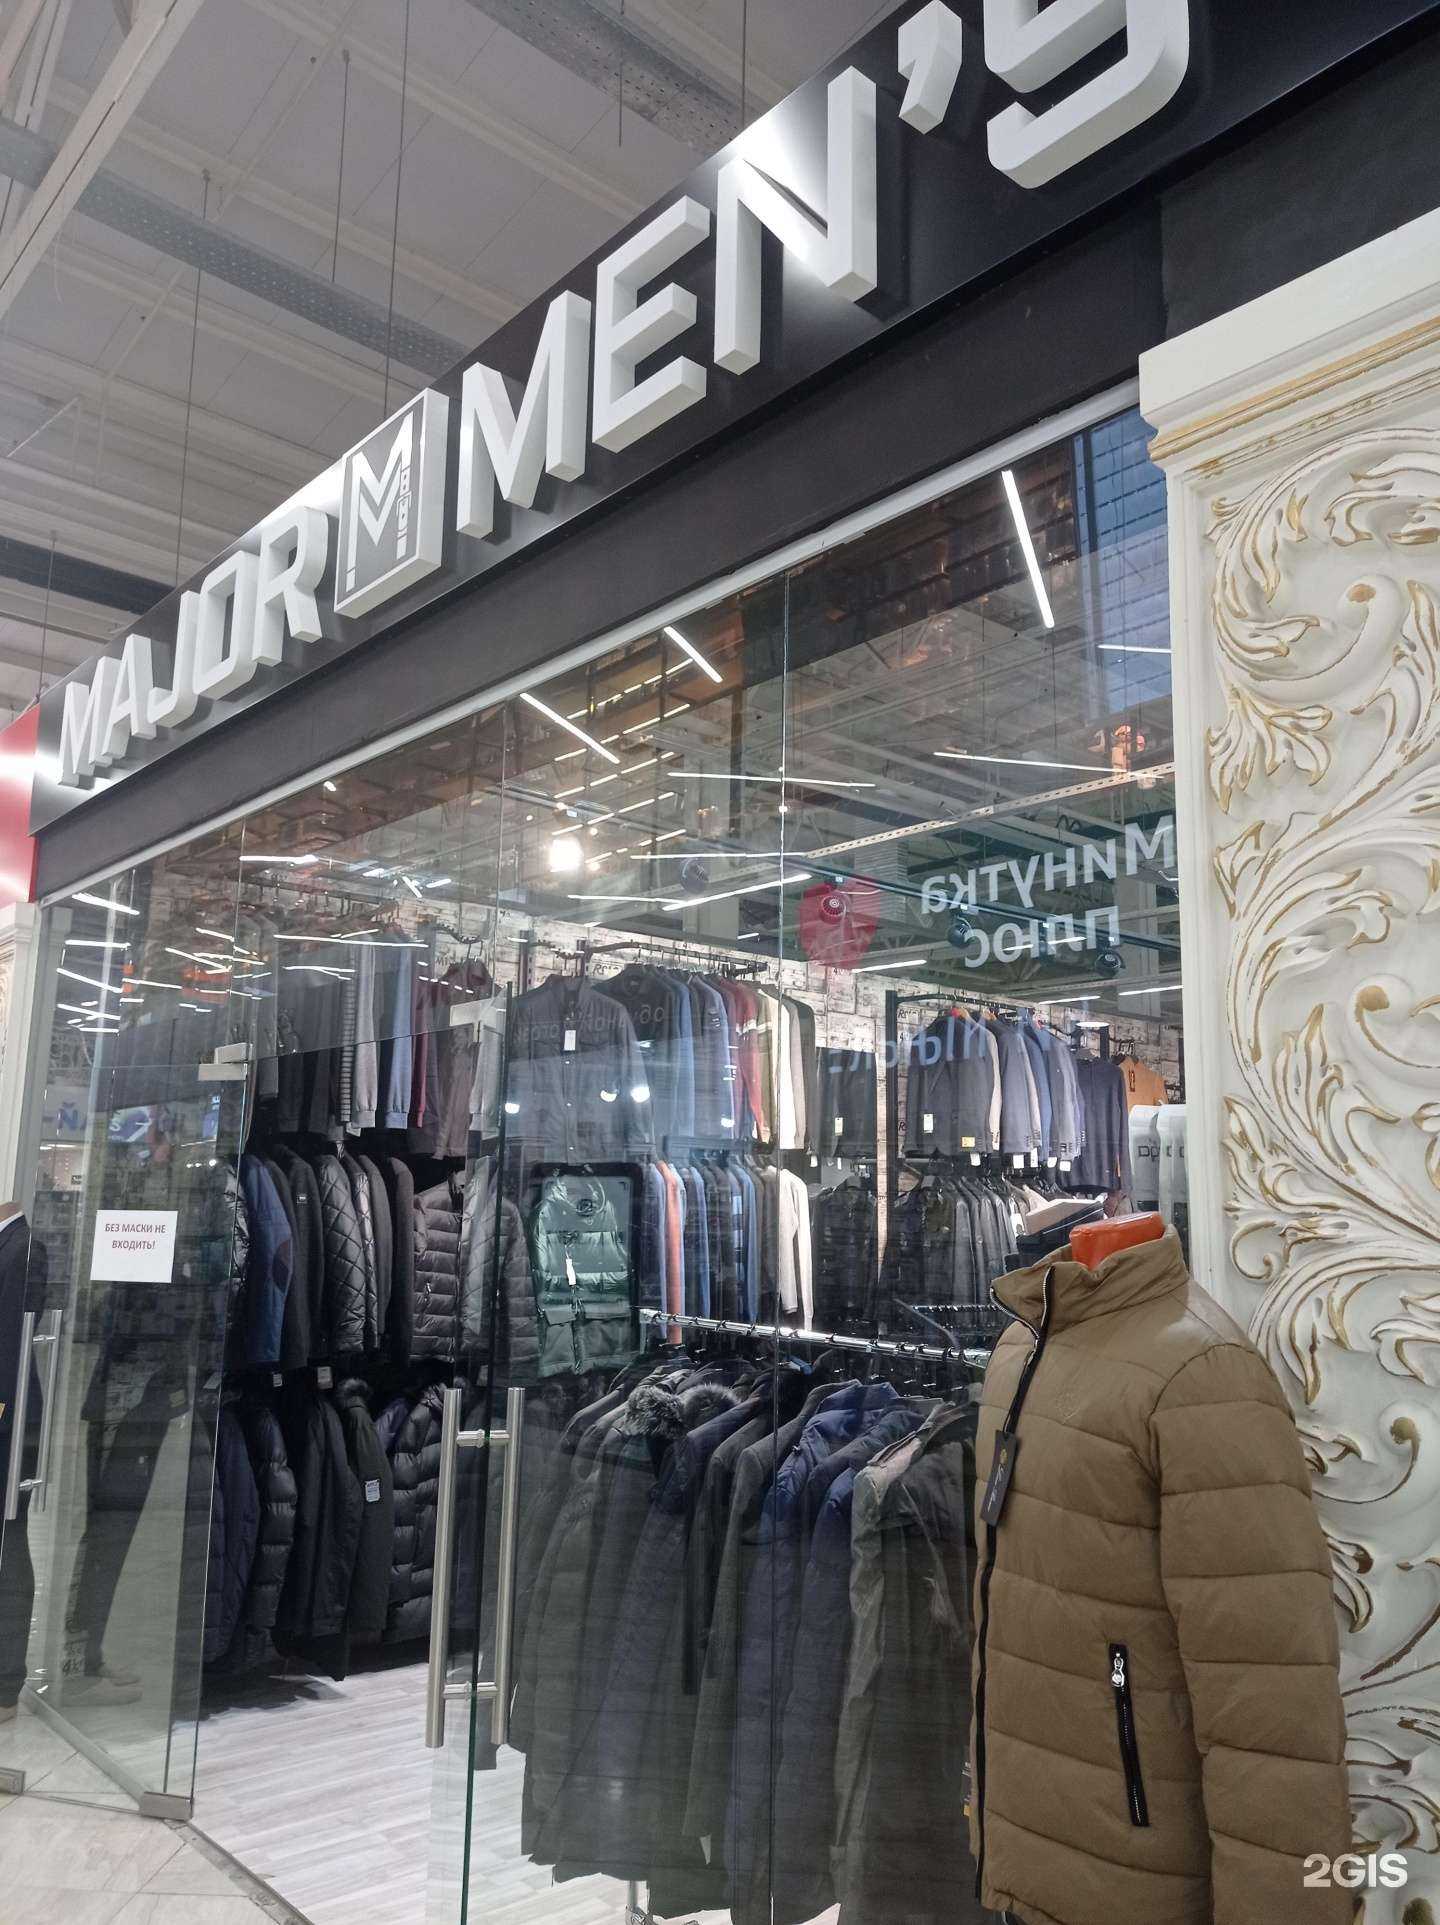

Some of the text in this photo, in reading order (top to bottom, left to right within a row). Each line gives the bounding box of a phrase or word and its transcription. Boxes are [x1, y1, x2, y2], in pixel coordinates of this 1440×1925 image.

[57, 505, 329, 790] MAJOR
[105, 1223, 166, 1234] БЕЗ МАСКИ НЕ
[111, 1240, 156, 1251] ВХОДИТЬ!
